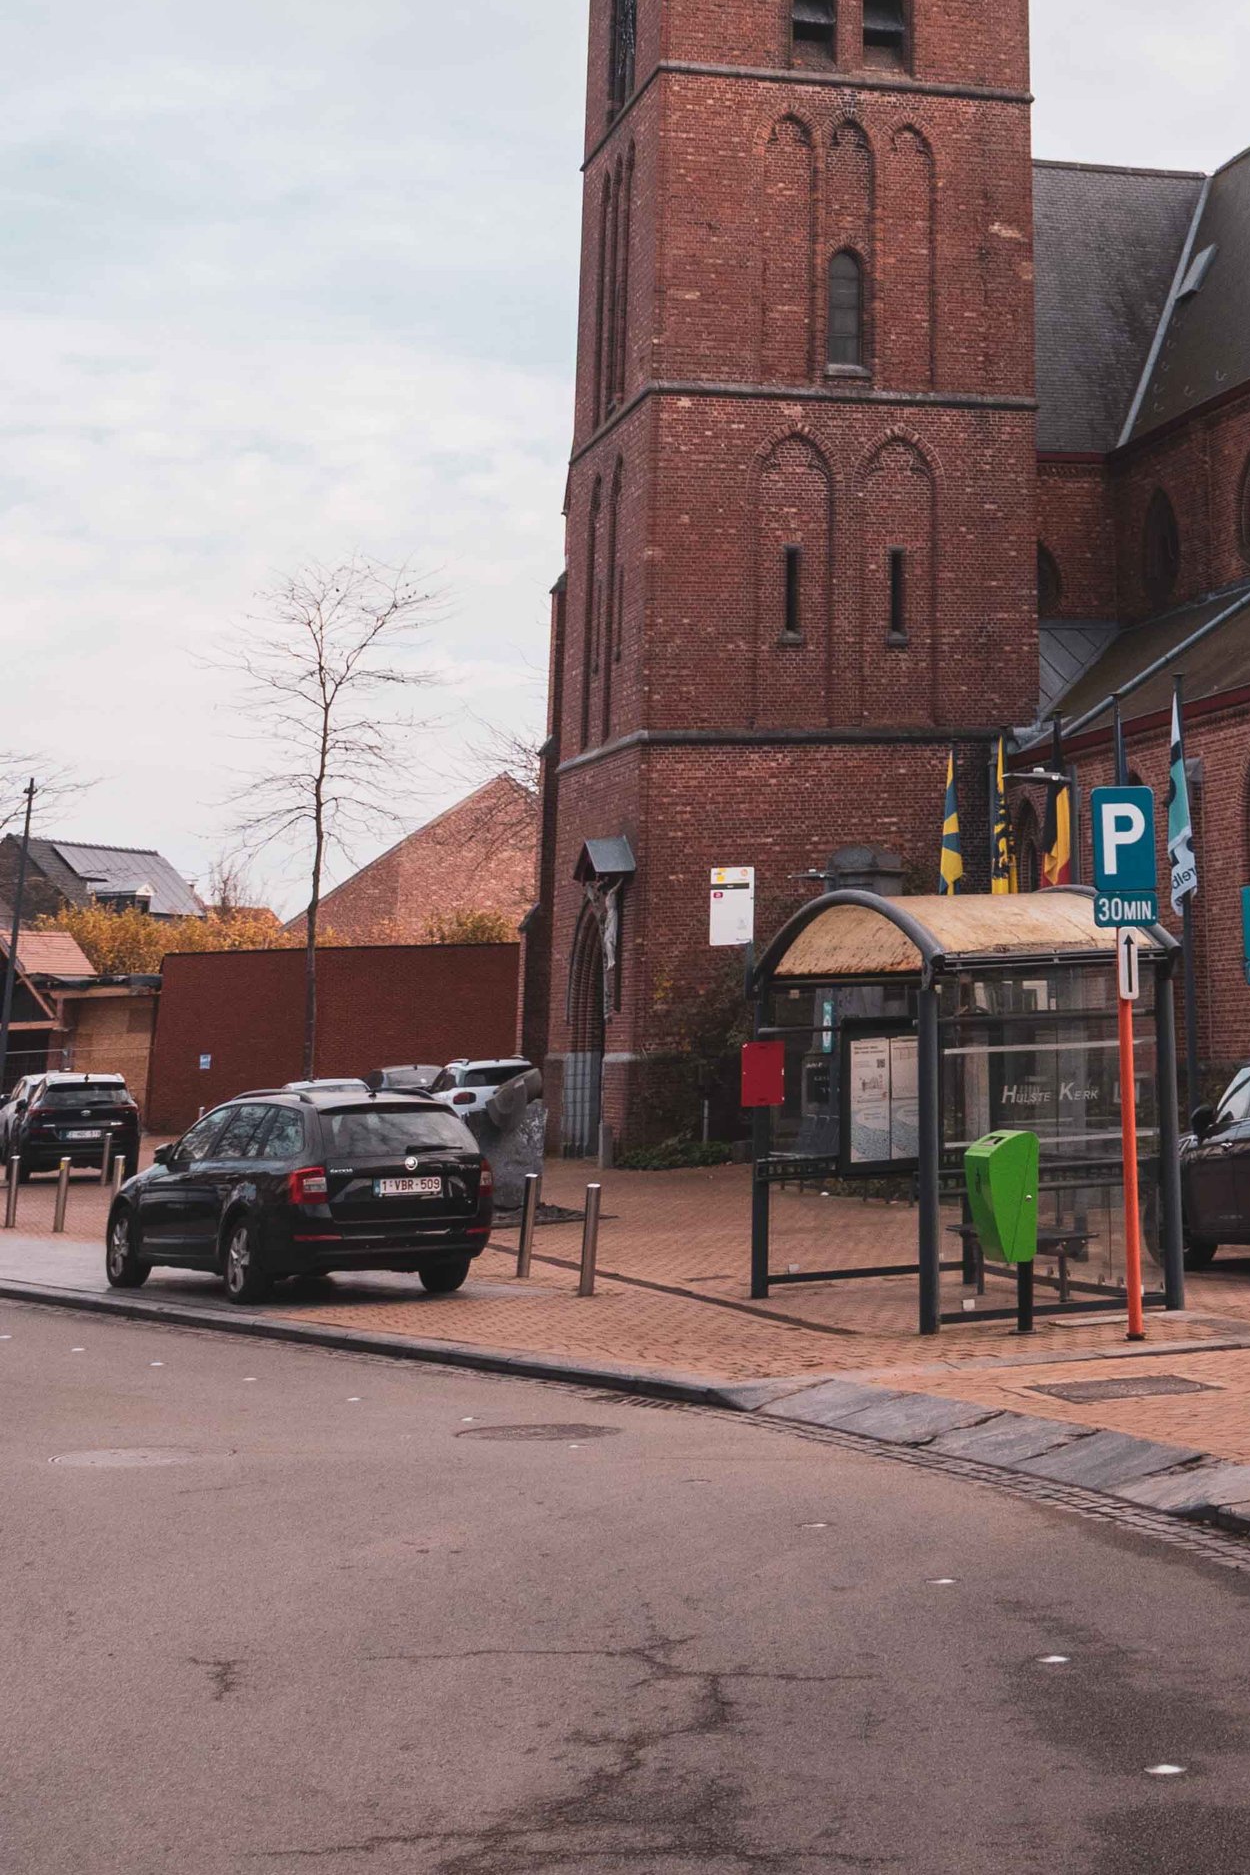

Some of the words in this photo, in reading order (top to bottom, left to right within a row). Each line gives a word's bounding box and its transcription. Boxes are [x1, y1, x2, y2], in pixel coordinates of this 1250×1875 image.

[1102, 803, 1145, 875] P
[1002, 1085, 1050, 1103] HULSTE
[1059, 1082, 1098, 1101] KERK
